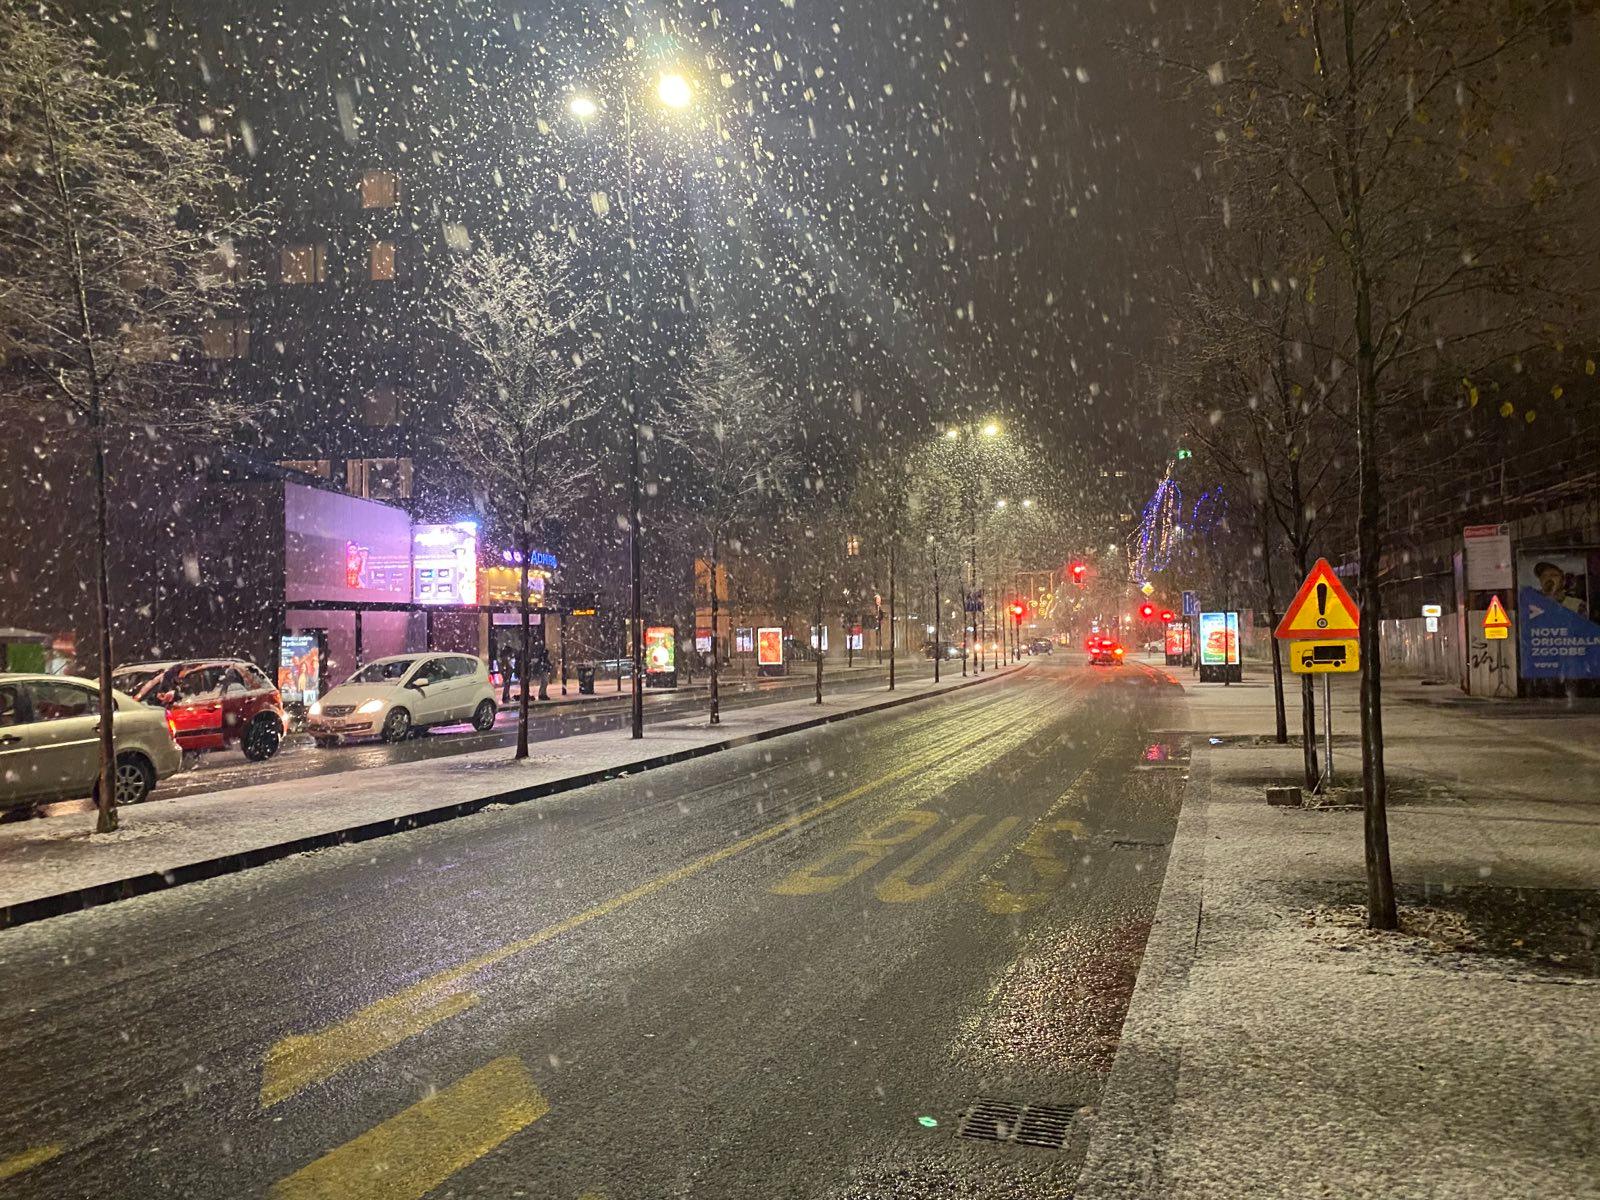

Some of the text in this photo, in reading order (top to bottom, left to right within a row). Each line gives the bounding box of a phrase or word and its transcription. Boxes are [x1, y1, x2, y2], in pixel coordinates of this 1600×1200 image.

[530, 550, 558, 568] ADMIRA
[1531, 628, 1569, 637] NOVE
[1531, 647, 1586, 656] ZGODBE
[768, 810, 1091, 914] BUS
